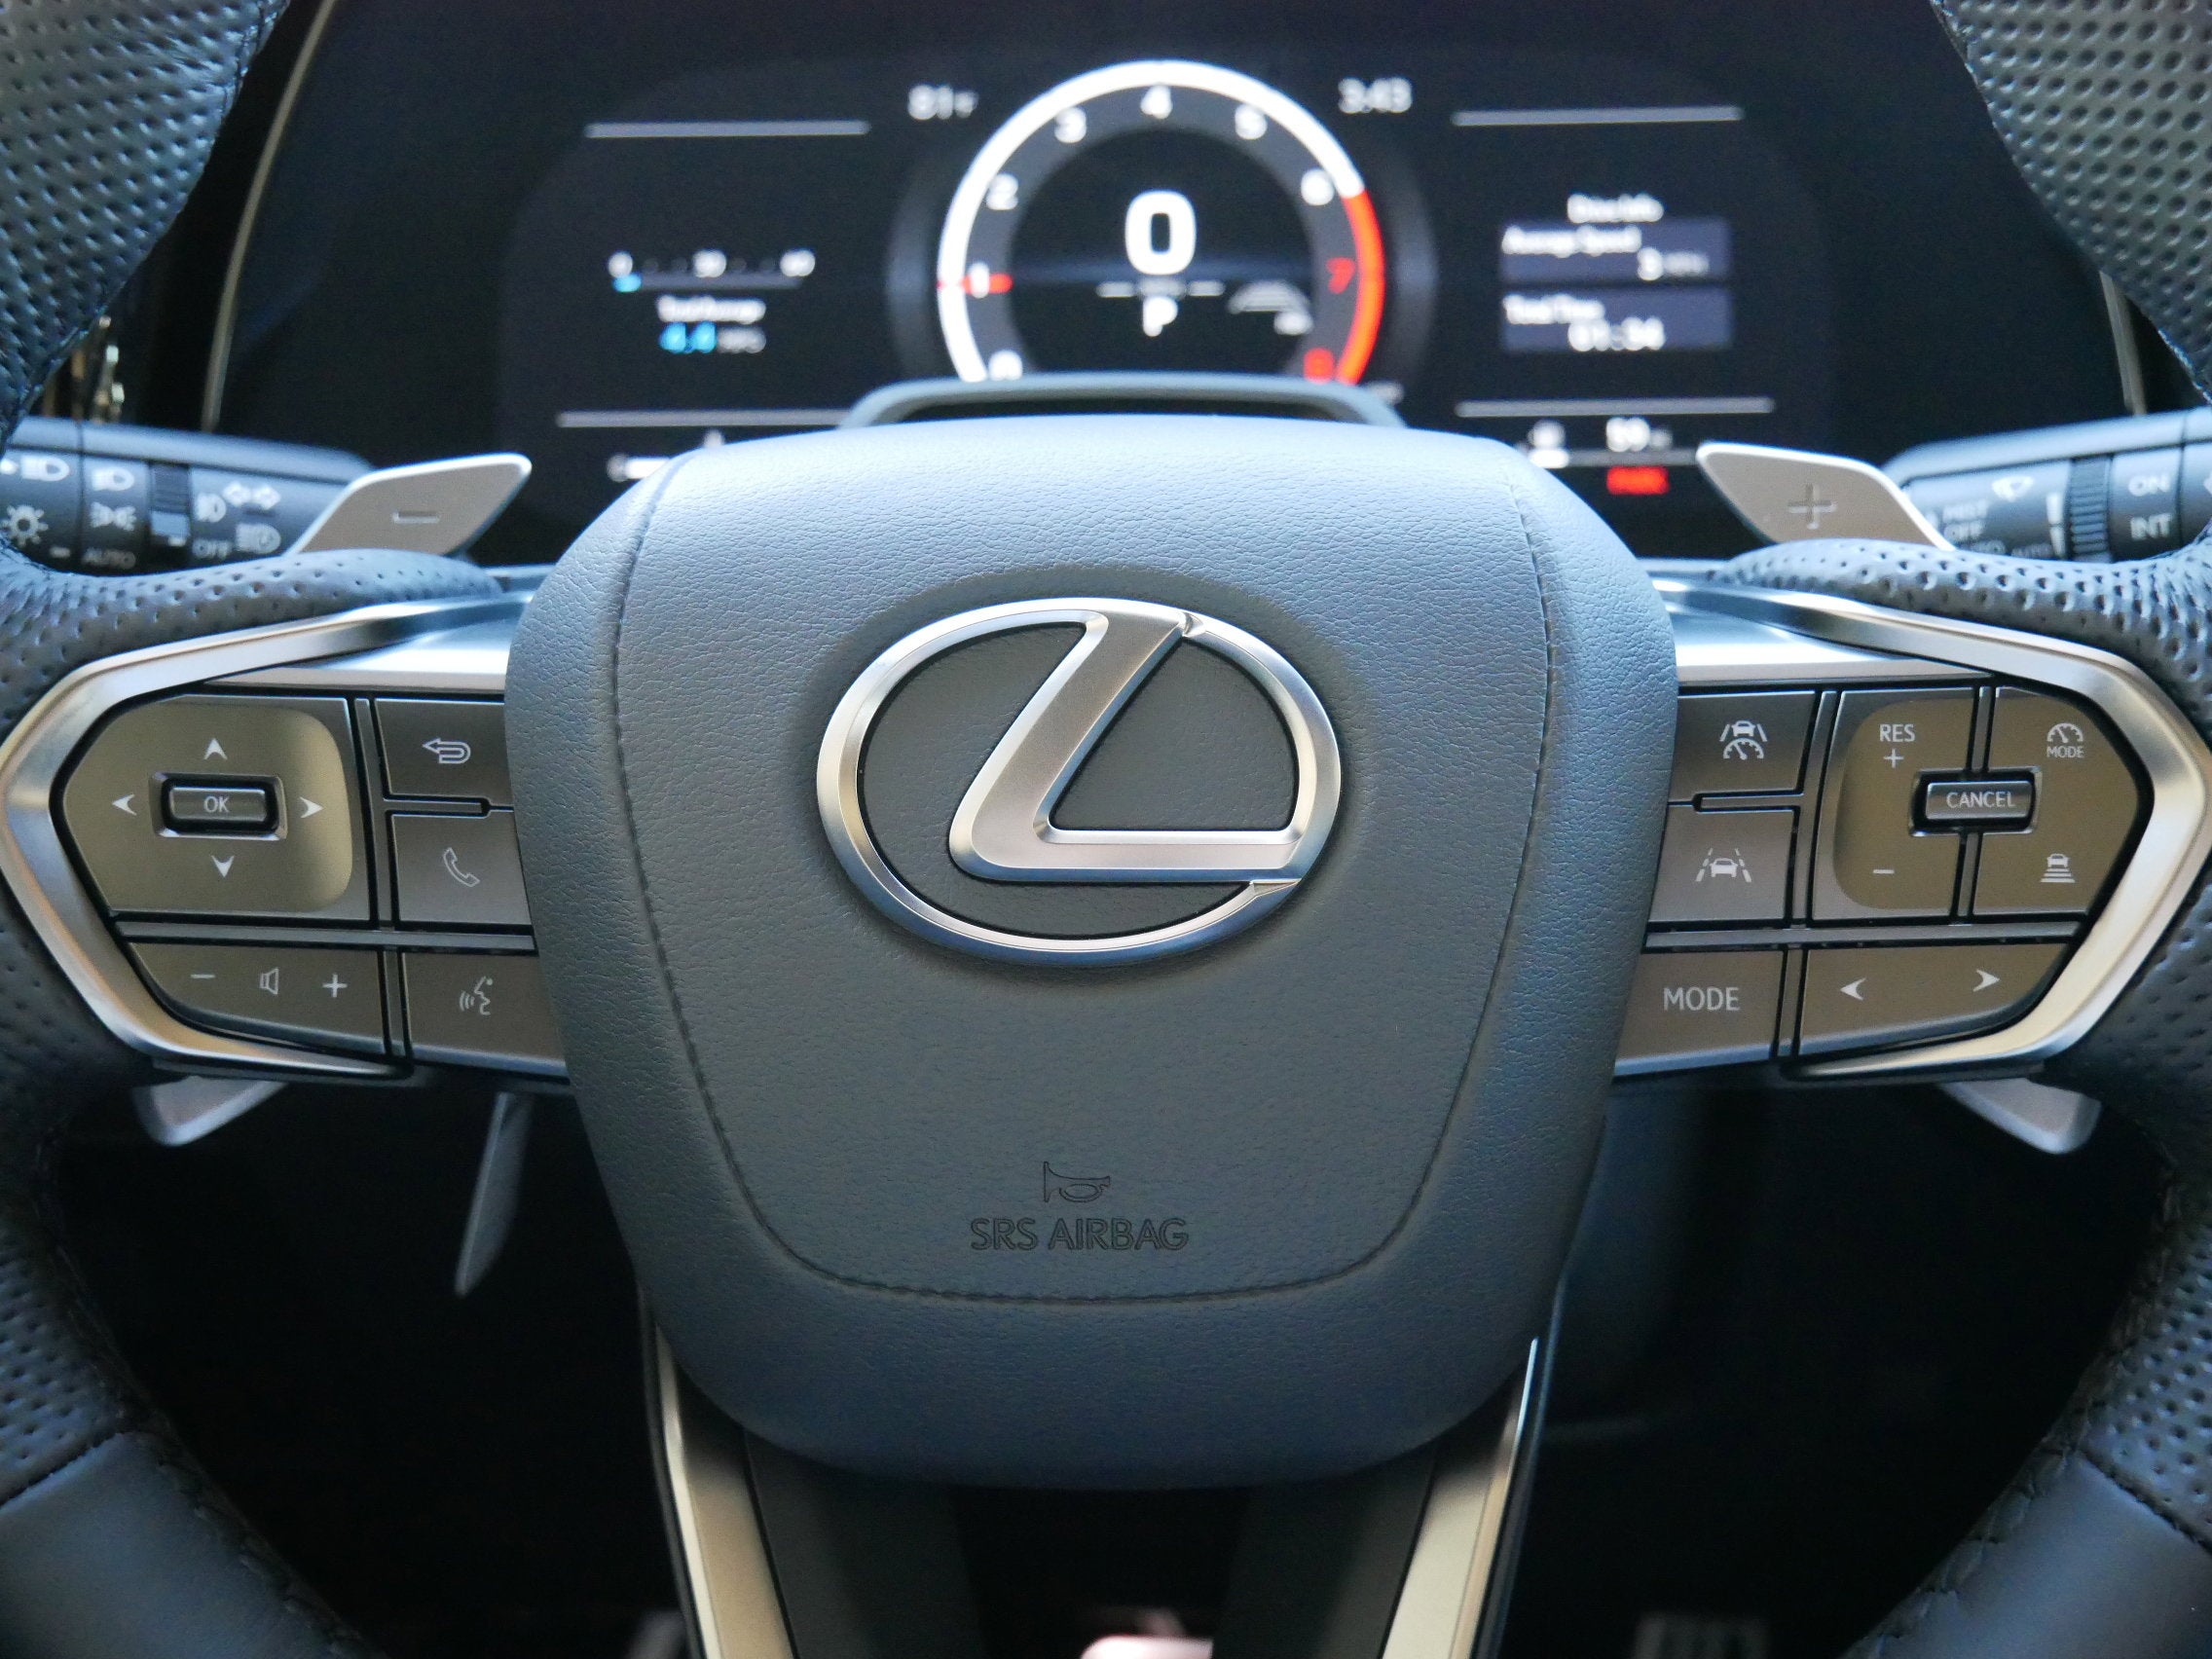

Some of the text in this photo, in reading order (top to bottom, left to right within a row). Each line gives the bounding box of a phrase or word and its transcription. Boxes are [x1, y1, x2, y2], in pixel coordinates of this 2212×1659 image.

[1125, 191, 1197, 275] 0
[1142, 294, 1178, 337] P
[1879, 723, 1915, 743] RES
[2046, 746, 2084, 758] MODE
[203, 795, 230, 813] OK
[1946, 791, 2015, 809] CANCEL
[1663, 986, 1741, 1011] MODE
[971, 1218, 1189, 1250] SRS AIRBAG
